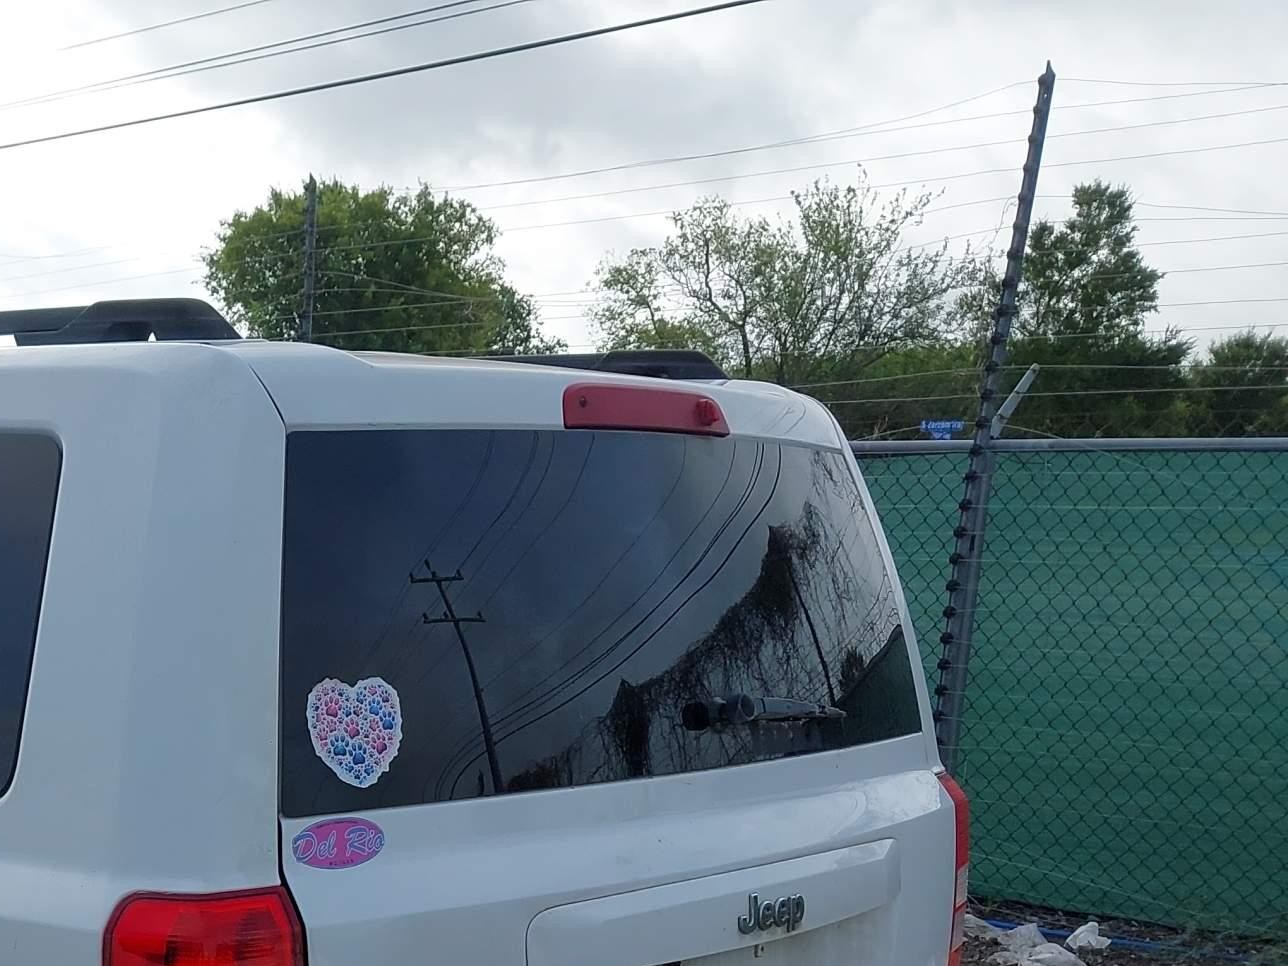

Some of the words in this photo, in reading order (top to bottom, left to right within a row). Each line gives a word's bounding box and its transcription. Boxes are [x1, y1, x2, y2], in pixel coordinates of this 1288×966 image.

[292, 830, 337, 862] Del
[344, 825, 385, 857] Rio
[737, 892, 806, 935] Jeep
